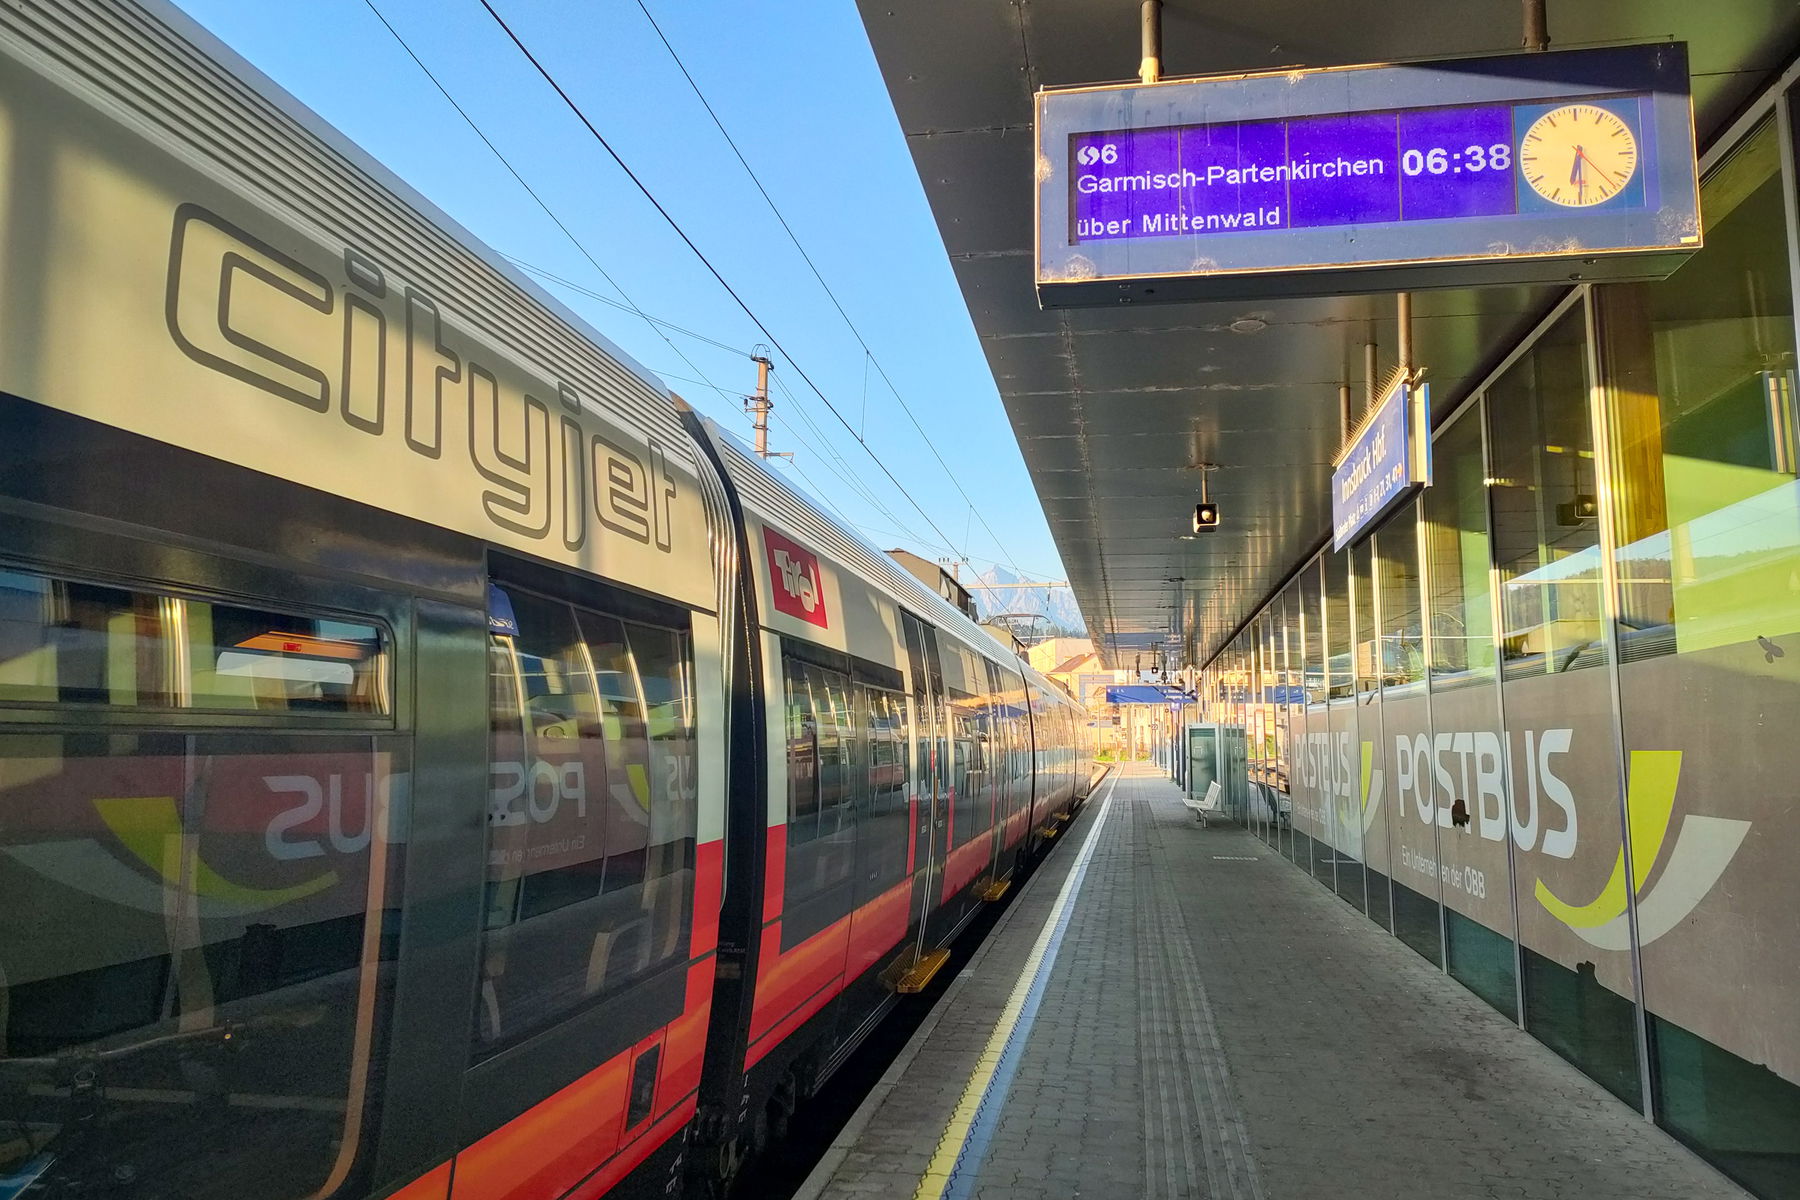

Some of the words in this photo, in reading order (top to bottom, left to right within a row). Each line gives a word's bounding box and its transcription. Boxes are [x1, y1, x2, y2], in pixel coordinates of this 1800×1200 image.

[1077, 155, 1384, 194] Garmisch-Partenkirchen
[1402, 143, 1511, 177] 06:38
[1077, 218, 1131, 237] über
[1142, 206, 1280, 233] Mittenwald
[1341, 446, 1372, 504] Innsbruck
[1395, 728, 1578, 860] POSTBUS
